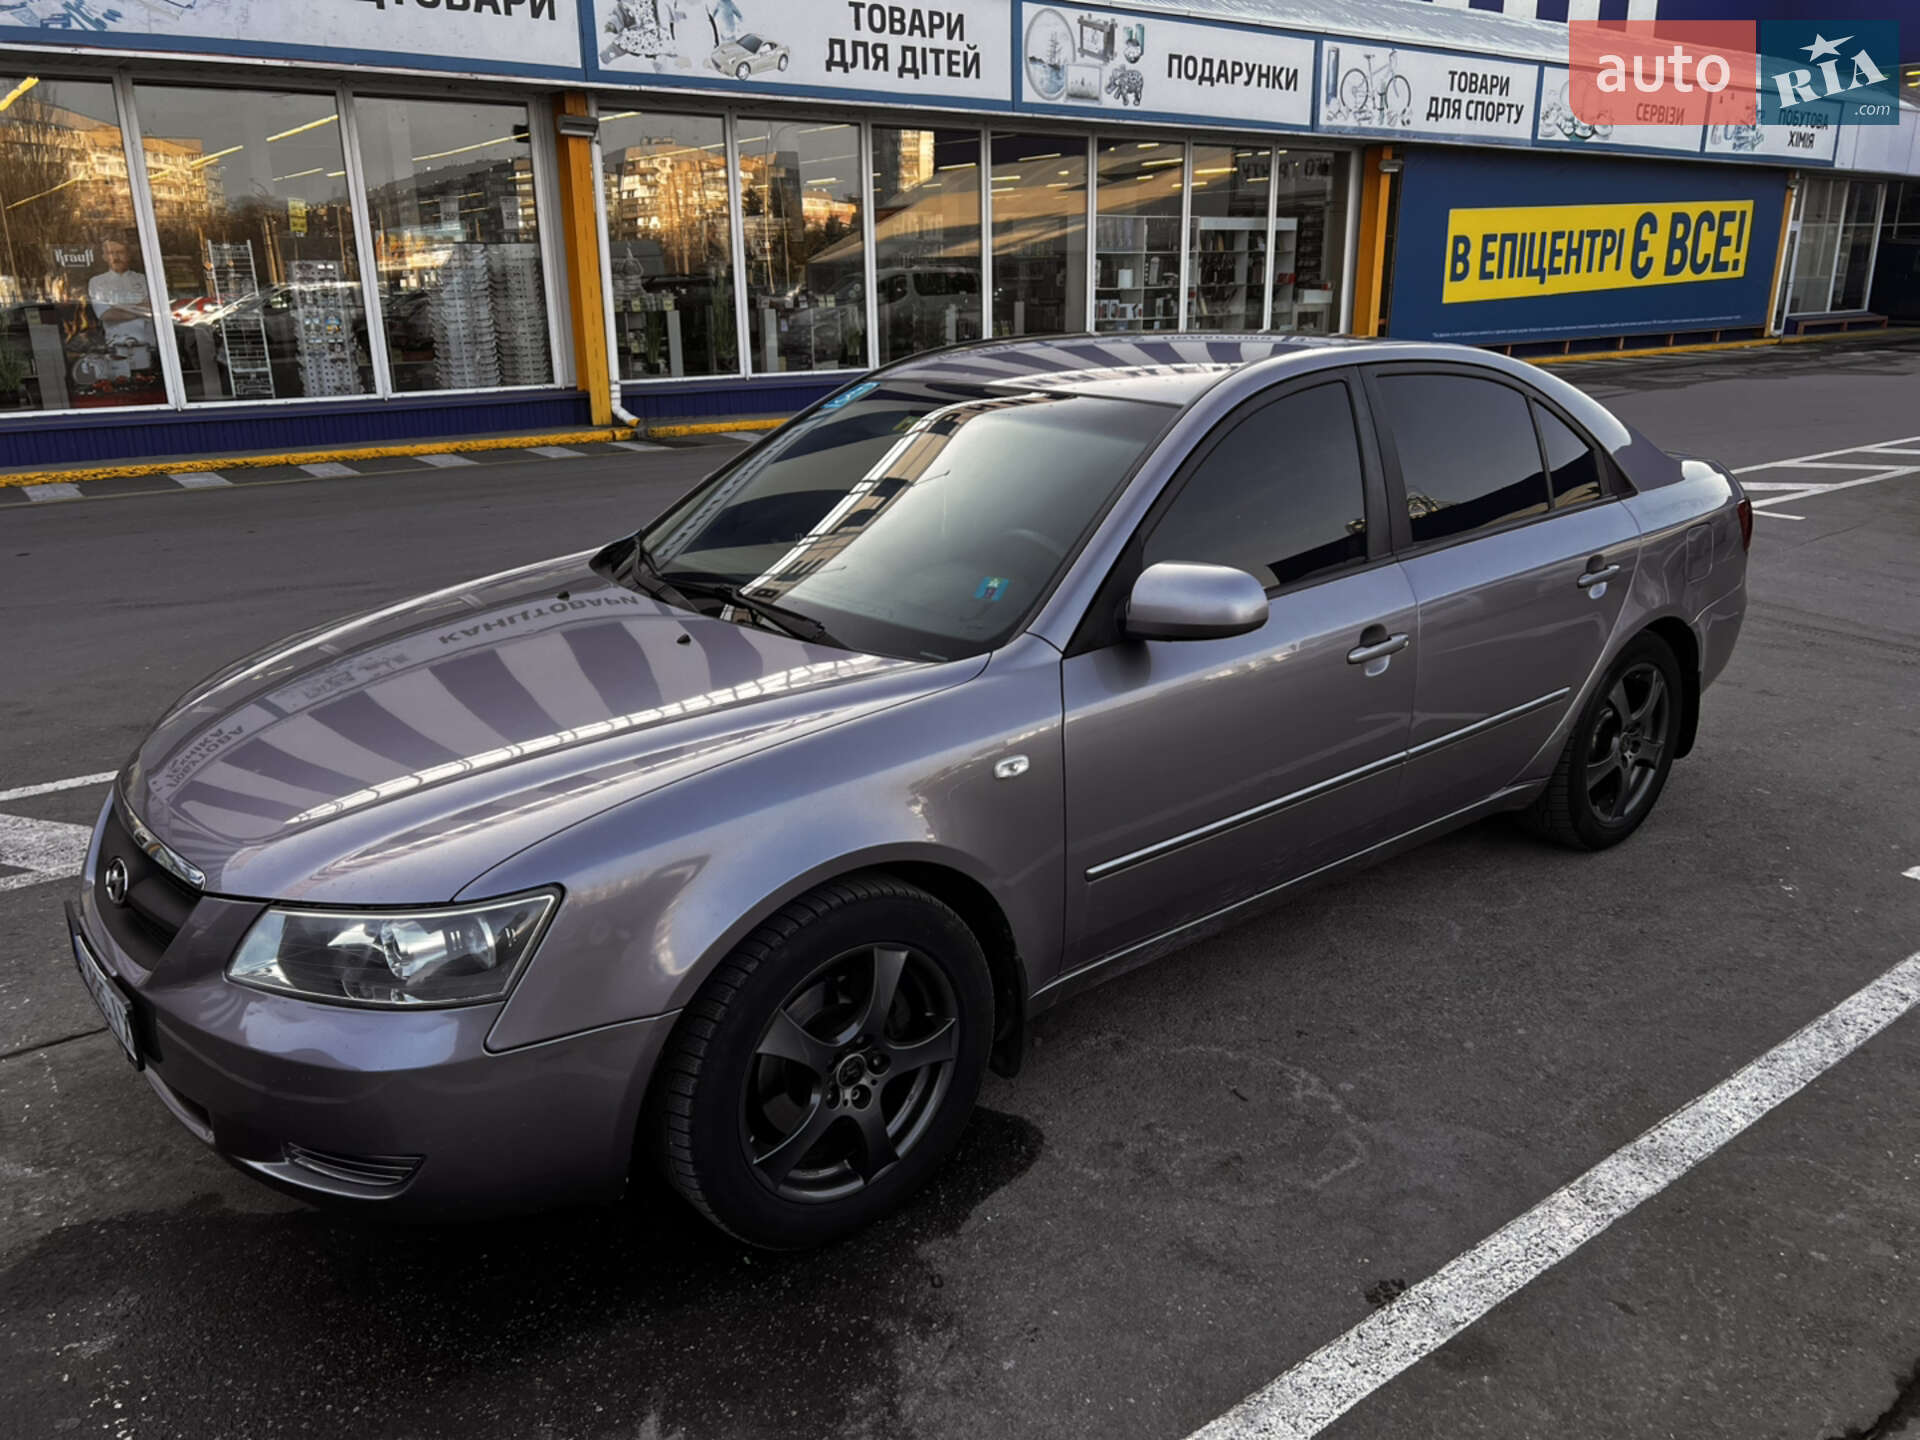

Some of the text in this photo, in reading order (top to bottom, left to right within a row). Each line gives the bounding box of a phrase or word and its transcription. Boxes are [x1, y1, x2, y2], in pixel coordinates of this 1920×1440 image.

[848, 1, 965, 42] ТОВАРИ
[825, 38, 981, 80] ДЛЯ ДІТЕЙ
[1167, 53, 1299, 92] ПОДАРУНКИ
[1448, 70, 1510, 97] ТОВАРИ
[1426, 96, 1525, 124] ДЛЯ СПОРТУ
[1635, 102, 1686, 125] СЕРВІЗИ
[1778, 108, 1829, 130] ПОБУТОВА
[1787, 130, 1816, 149] ХІМІЯ
[1449, 209, 1748, 285] В ЕПІЦЕНТРІ Є ВСЕ!
